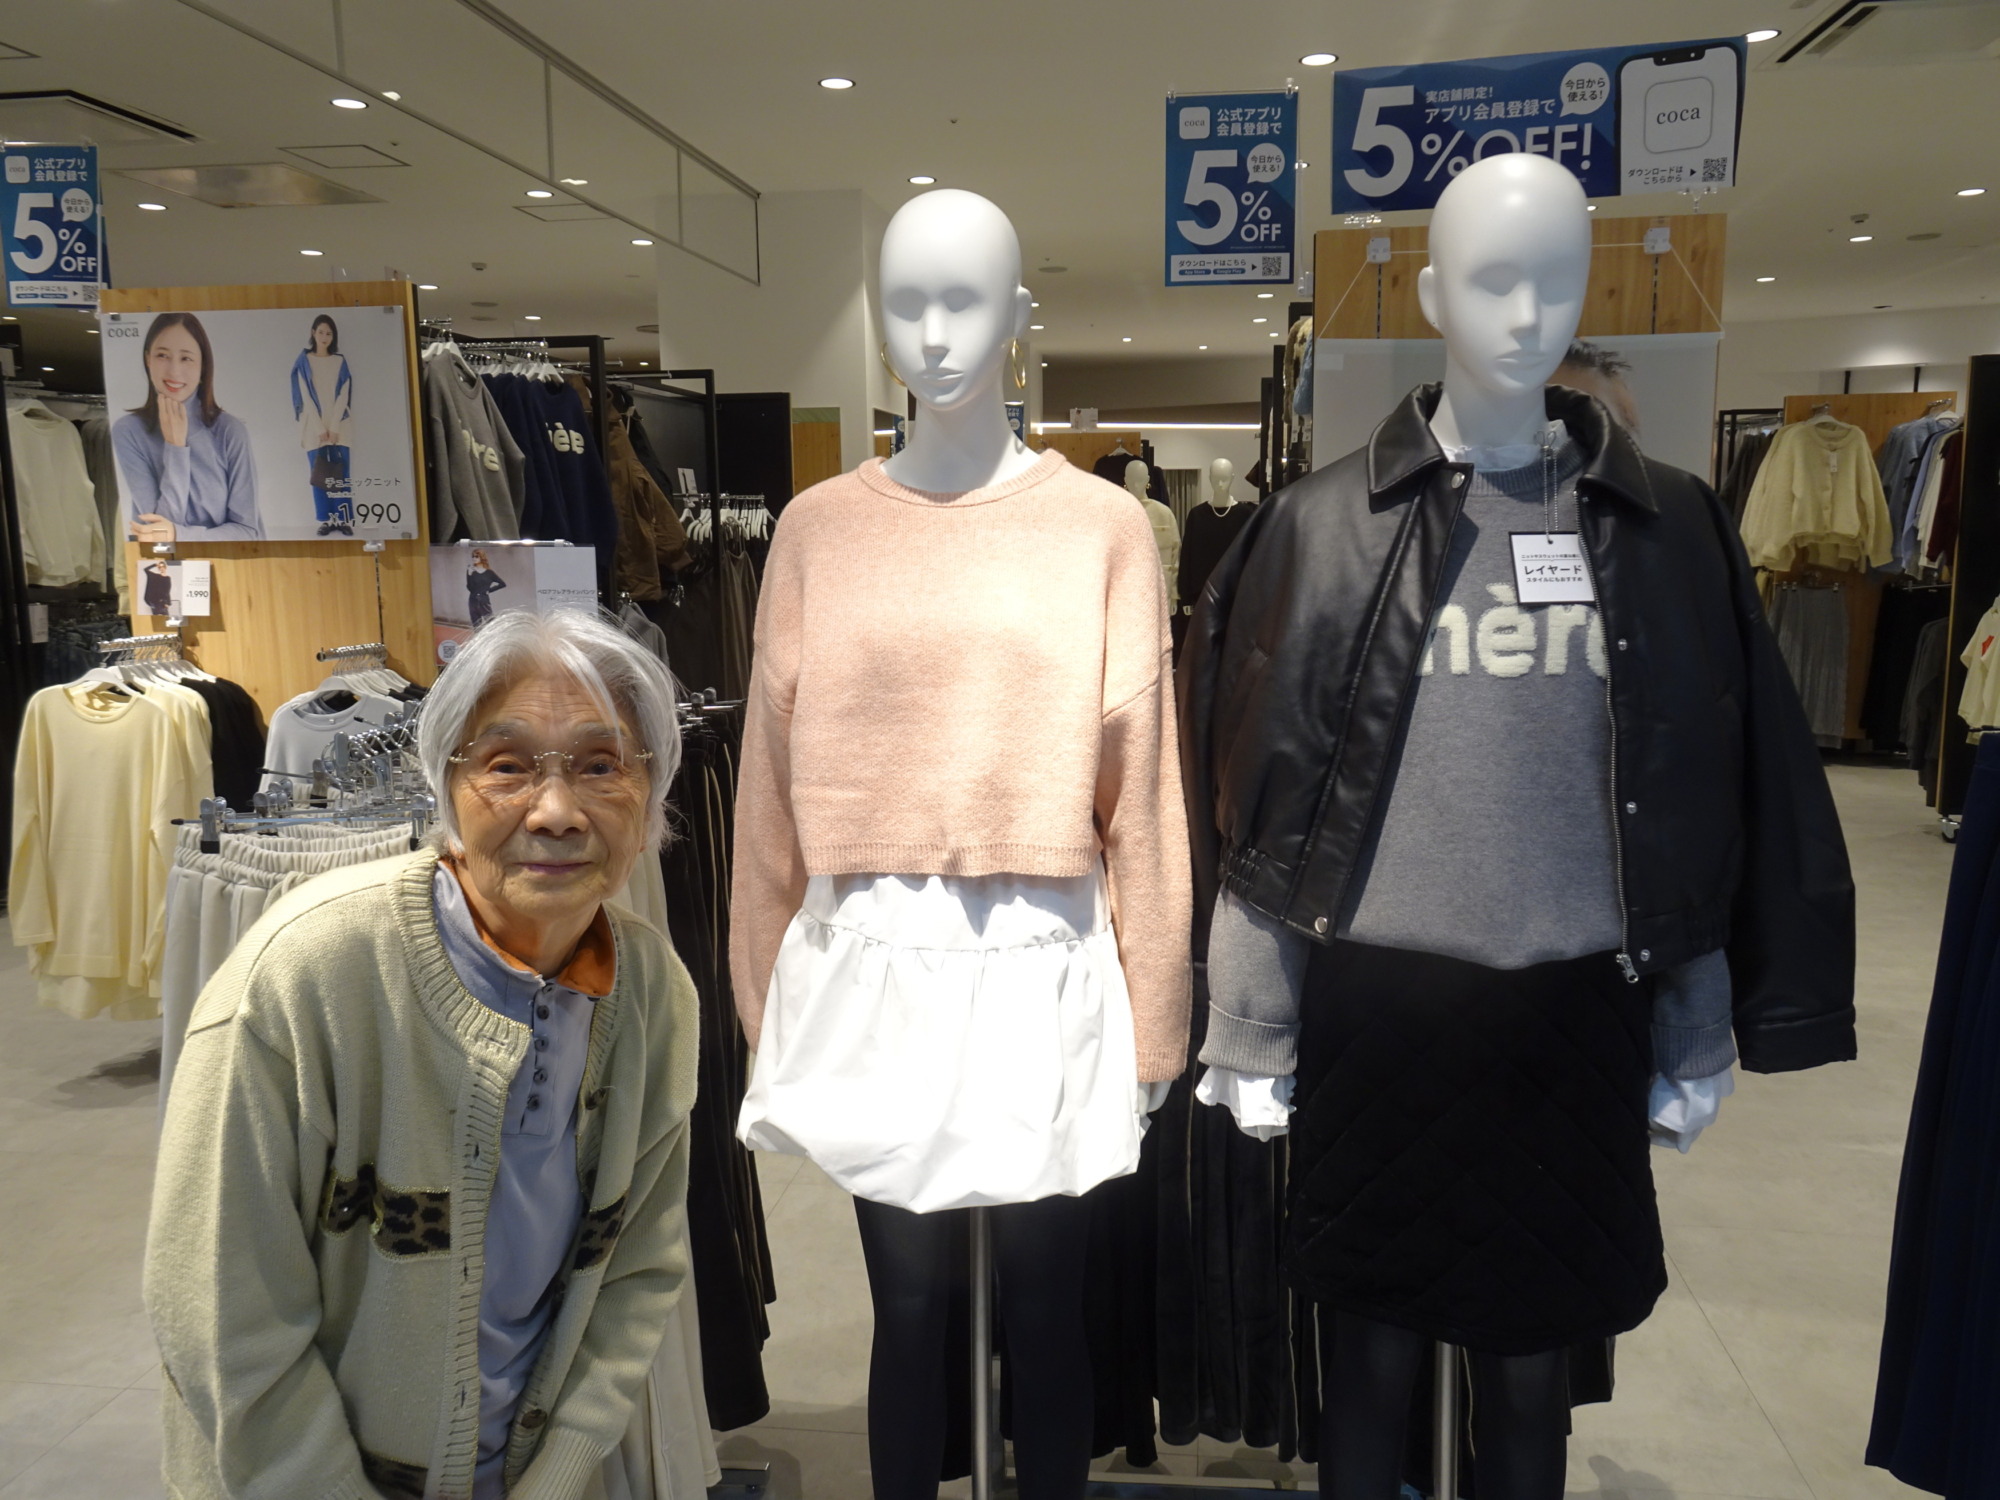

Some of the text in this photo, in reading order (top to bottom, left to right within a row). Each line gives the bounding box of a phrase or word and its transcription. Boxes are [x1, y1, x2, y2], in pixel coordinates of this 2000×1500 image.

[1565, 77, 1606, 91] 今日から
[1426, 87, 1493, 103] 実店舗限定!
[1217, 107, 1282, 122] 公式アプリ
[1425, 99, 1556, 124] アプリ会員登録で
[1656, 106, 1700, 125] coca
[1184, 119, 1206, 127] coca
[1217, 122, 1282, 137] 会員登録で
[34, 157, 86, 170] 公式アプリ
[1250, 155, 1282, 163] 今日から
[35, 170, 88, 182] 会員登録で
[1627, 166, 1684, 178] ダウンロードは
[1643, 174, 1682, 185] こちらから
[1240, 223, 1282, 243] OFF
[60, 256, 97, 273] OFF
[1178, 259, 1247, 268] ダウンロードはこちら
[108, 327, 139, 338] coca
[324, 477, 401, 489] チュニックニット
[329, 503, 402, 527] ¥1,990
[1524, 565, 1582, 575] レイヤード
